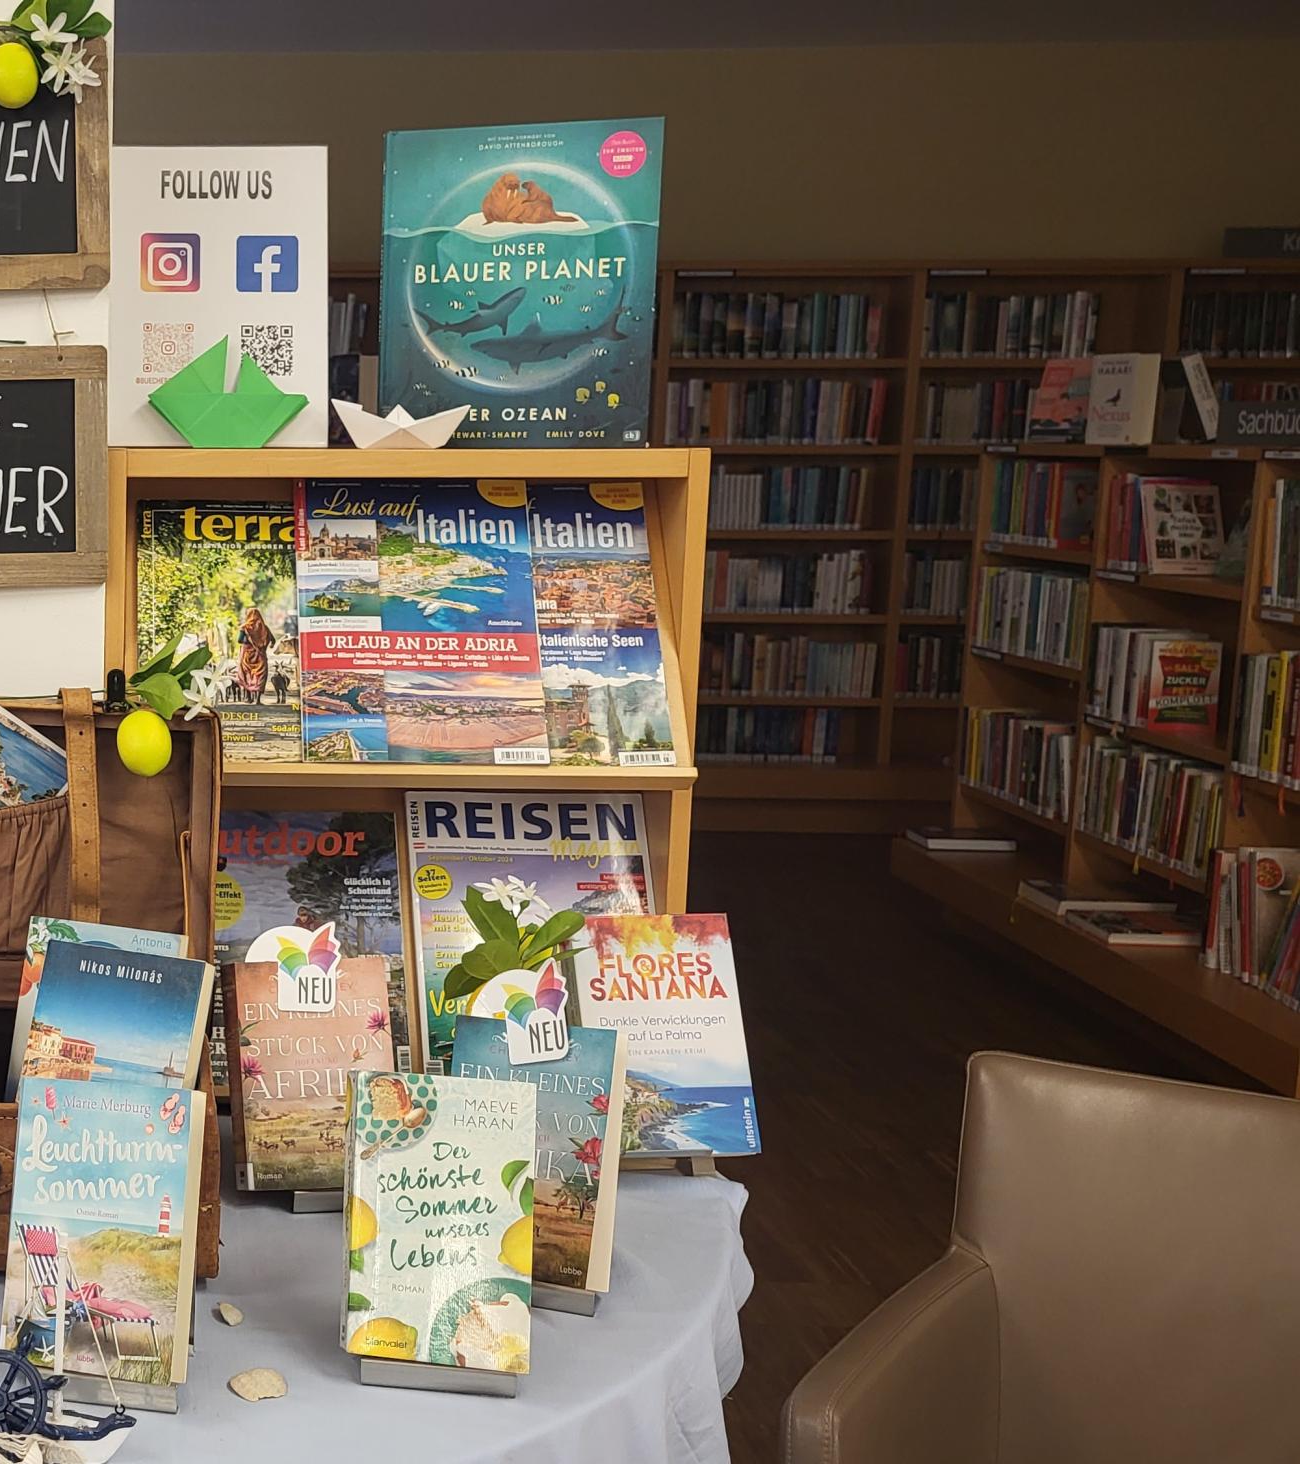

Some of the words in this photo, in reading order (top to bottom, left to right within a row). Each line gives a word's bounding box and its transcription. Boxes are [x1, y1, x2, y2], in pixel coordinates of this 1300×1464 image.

[479, 143, 502, 151] DAVID
[161, 170, 240, 200] FOLLOW
[247, 170, 274, 200] US
[492, 243, 546, 257] UNSER
[414, 262, 512, 284] BLAUER
[524, 257, 627, 281] PLANET
[468, 408, 491, 421] ER
[501, 407, 568, 421] OZEAN
[1091, 406, 1131, 423] Nexus
[1237, 407, 1300, 436] Sachbüc
[546, 430, 574, 439] EMILY
[578, 430, 605, 439] DOVE
[312, 488, 376, 518] Lust
[378, 495, 421, 526] auf
[141, 510, 152, 538] terra
[417, 509, 517, 545] Italien
[532, 513, 634, 549] Italien
[324, 635, 391, 650] URLAUB
[394, 636, 421, 650] AN
[425, 636, 461, 651] DER
[465, 637, 519, 652] ADRIA
[612, 634, 644, 648] Seen
[1165, 674, 1208, 688] ZUCKER
[411, 800, 421, 838] REISEN
[424, 800, 637, 841] REISEN
[218, 822, 365, 857] utdoor
[343, 877, 381, 886] Glücklich
[382, 877, 391, 886] in
[347, 886, 392, 895] Schottland
[417, 874, 446, 883] Seiten
[131, 934, 172, 950] Antonia
[79, 959, 112, 976] Nikos
[116, 964, 164, 985] Milonás
[599, 952, 713, 978] FLORES
[298, 976, 333, 1005] NEU
[589, 975, 729, 1001] SANTANA
[244, 1003, 280, 1021] EIN
[429, 990, 467, 1017] Ver
[599, 1015, 639, 1027] Dunkle
[642, 1014, 726, 1029] Verwicklungen
[247, 1034, 326, 1057] STÜCK
[336, 1033, 385, 1053] VON
[529, 1019, 566, 1055] NEU
[628, 1029, 647, 1041] auf
[649, 1029, 663, 1041] La
[665, 1029, 702, 1041] Palma
[63, 1094, 98, 1110] Marie
[100, 1096, 153, 1119] Merburg
[464, 1098, 518, 1115] MAEVE
[453, 1114, 515, 1131] HARAN
[552, 1112, 600, 1137] VON
[741, 1108, 756, 1149] ullstein
[21, 1113, 184, 1173] Leuchtturm-
[432, 1142, 471, 1162] Der
[33, 1172, 161, 1203] sommer
[256, 1172, 283, 1181] Roman
[377, 1166, 485, 1195] schönste
[395, 1195, 498, 1224] Sommer
[425, 1221, 489, 1239] unseres
[389, 1238, 478, 1272] Lebens
[391, 1283, 425, 1294] ROMAN
[364, 1336, 408, 1349] blanvalet
